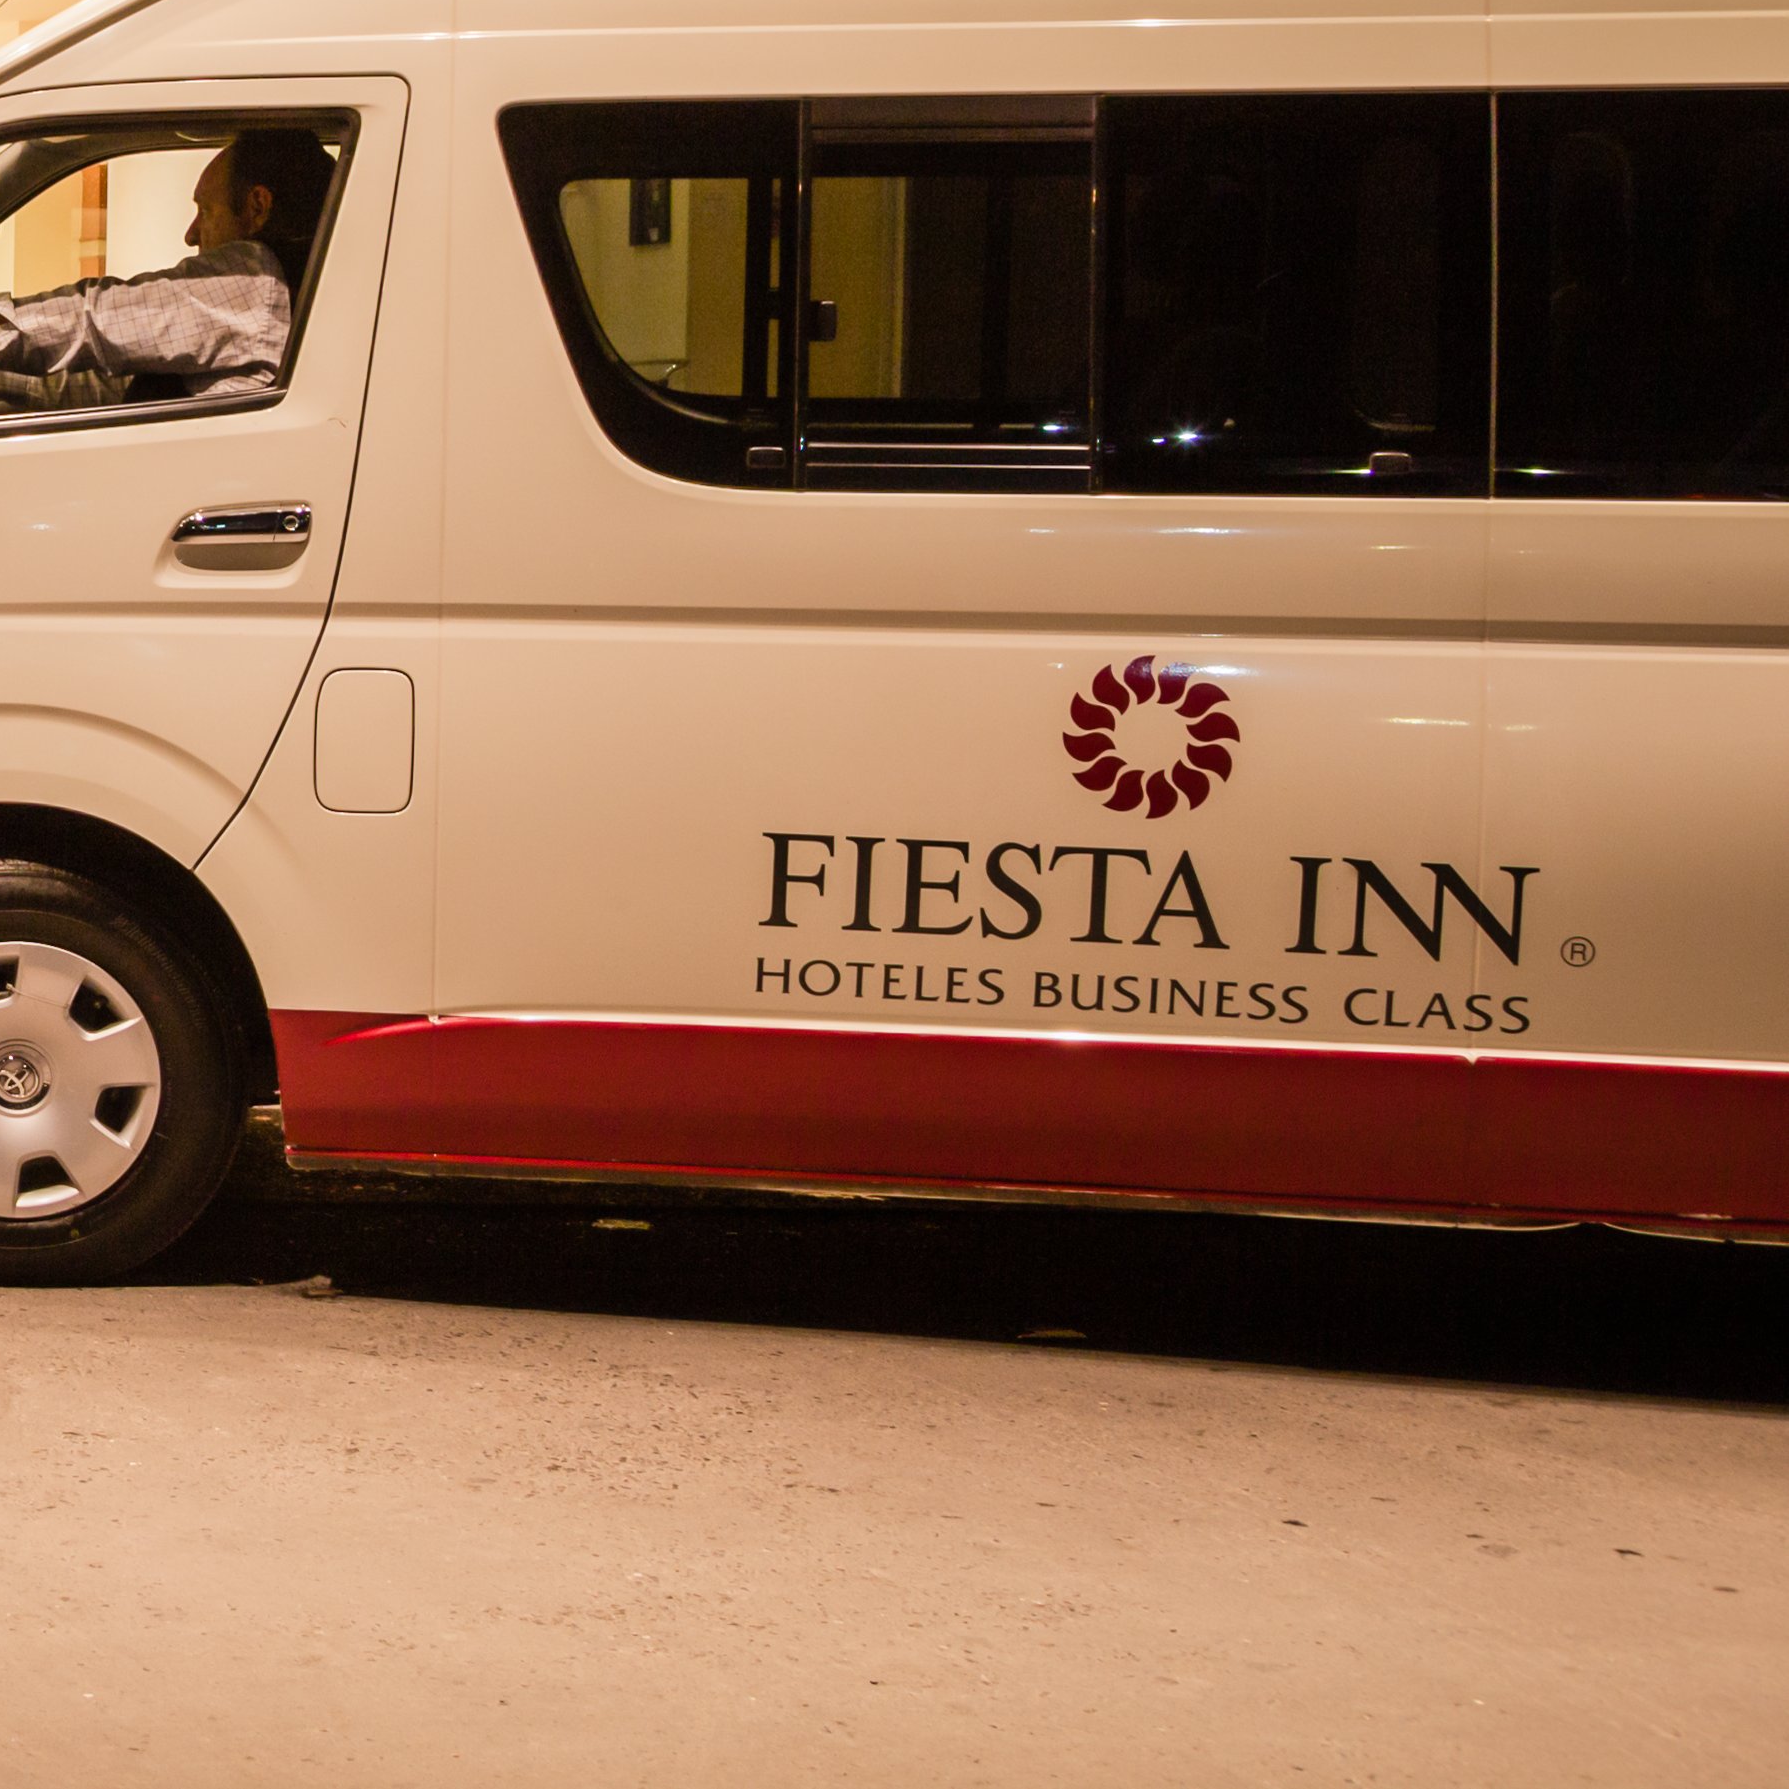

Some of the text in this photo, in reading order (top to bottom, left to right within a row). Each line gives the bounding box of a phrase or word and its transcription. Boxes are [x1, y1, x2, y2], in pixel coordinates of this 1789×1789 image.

[759, 832, 1230, 950] FIESTA
[1284, 856, 1541, 967] INN
[755, 957, 1531, 1035] HOTELES BUSINESS CLASS
